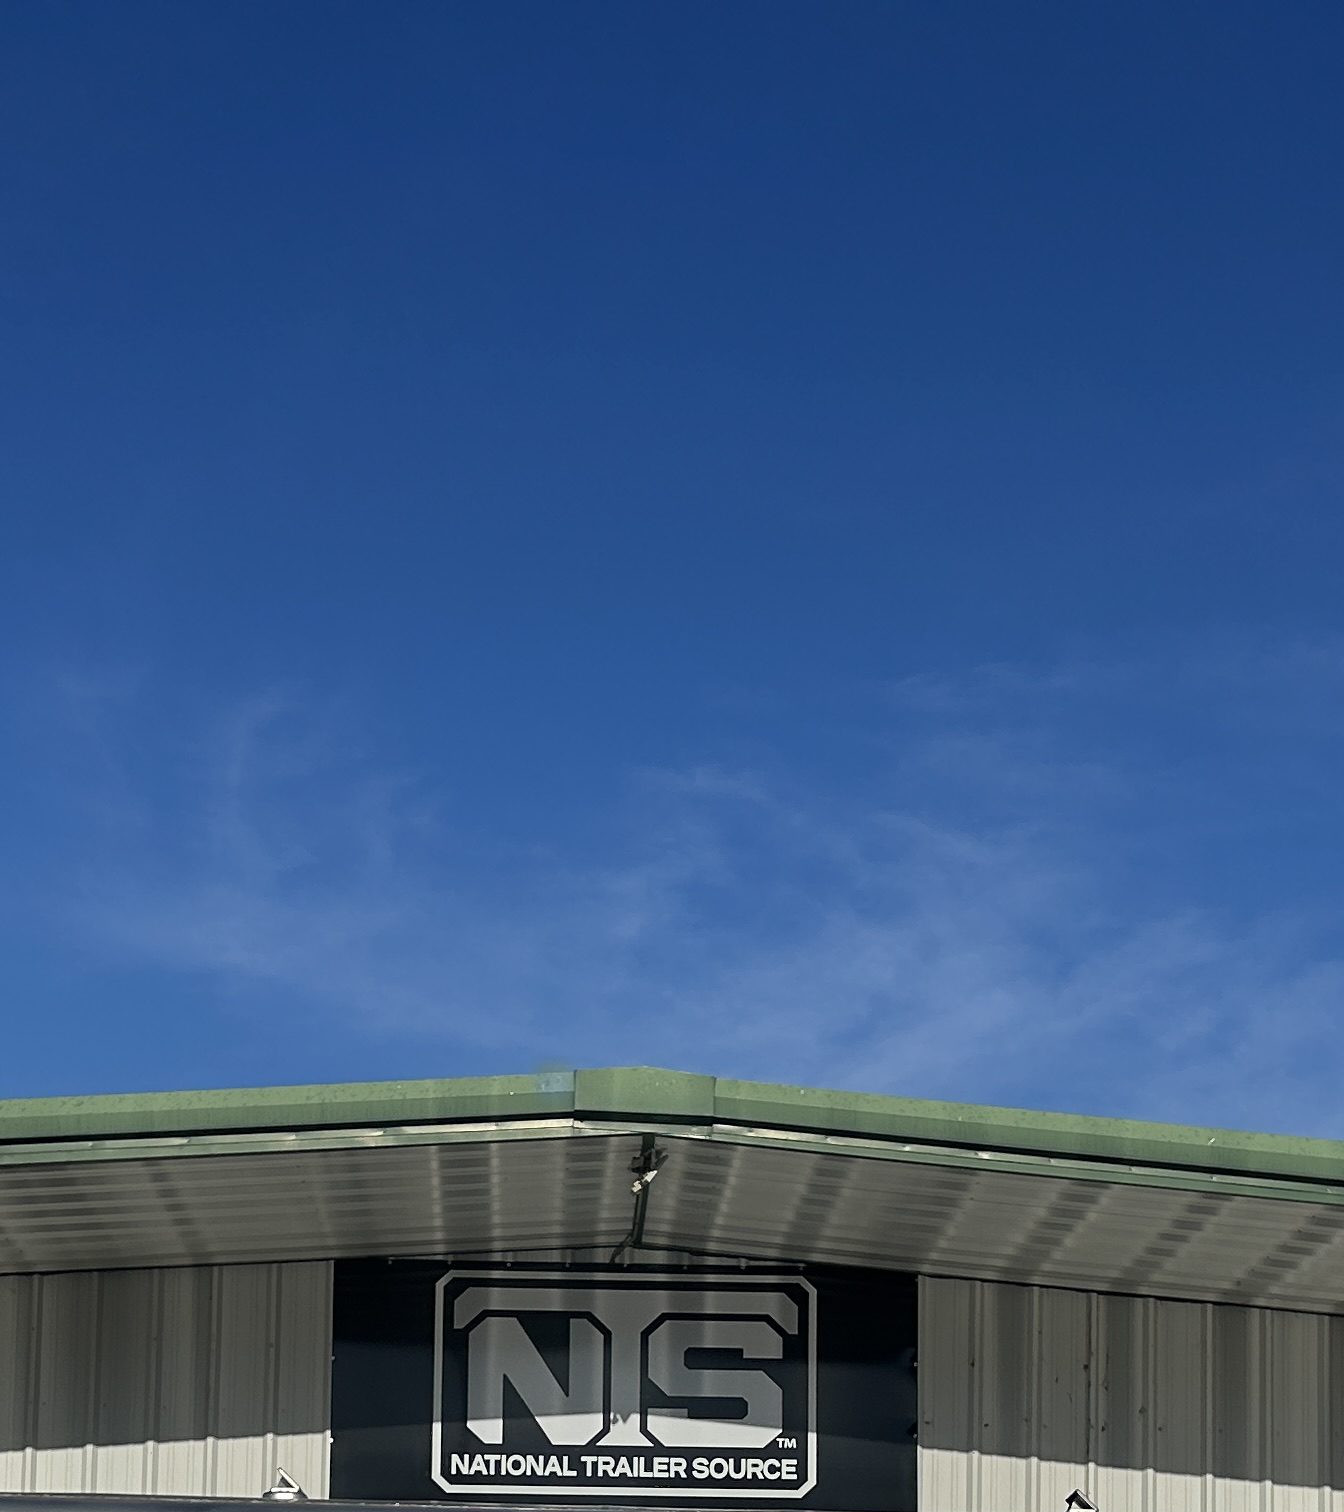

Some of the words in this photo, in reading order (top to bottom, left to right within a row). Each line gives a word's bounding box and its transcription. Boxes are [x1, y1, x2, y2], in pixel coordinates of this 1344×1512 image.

[453, 1287, 799, 1448] NTS
[449, 1453, 577, 1478] NATIONAL
[581, 1455, 687, 1479] TRAILER
[692, 1456, 798, 1481] SOURCE
